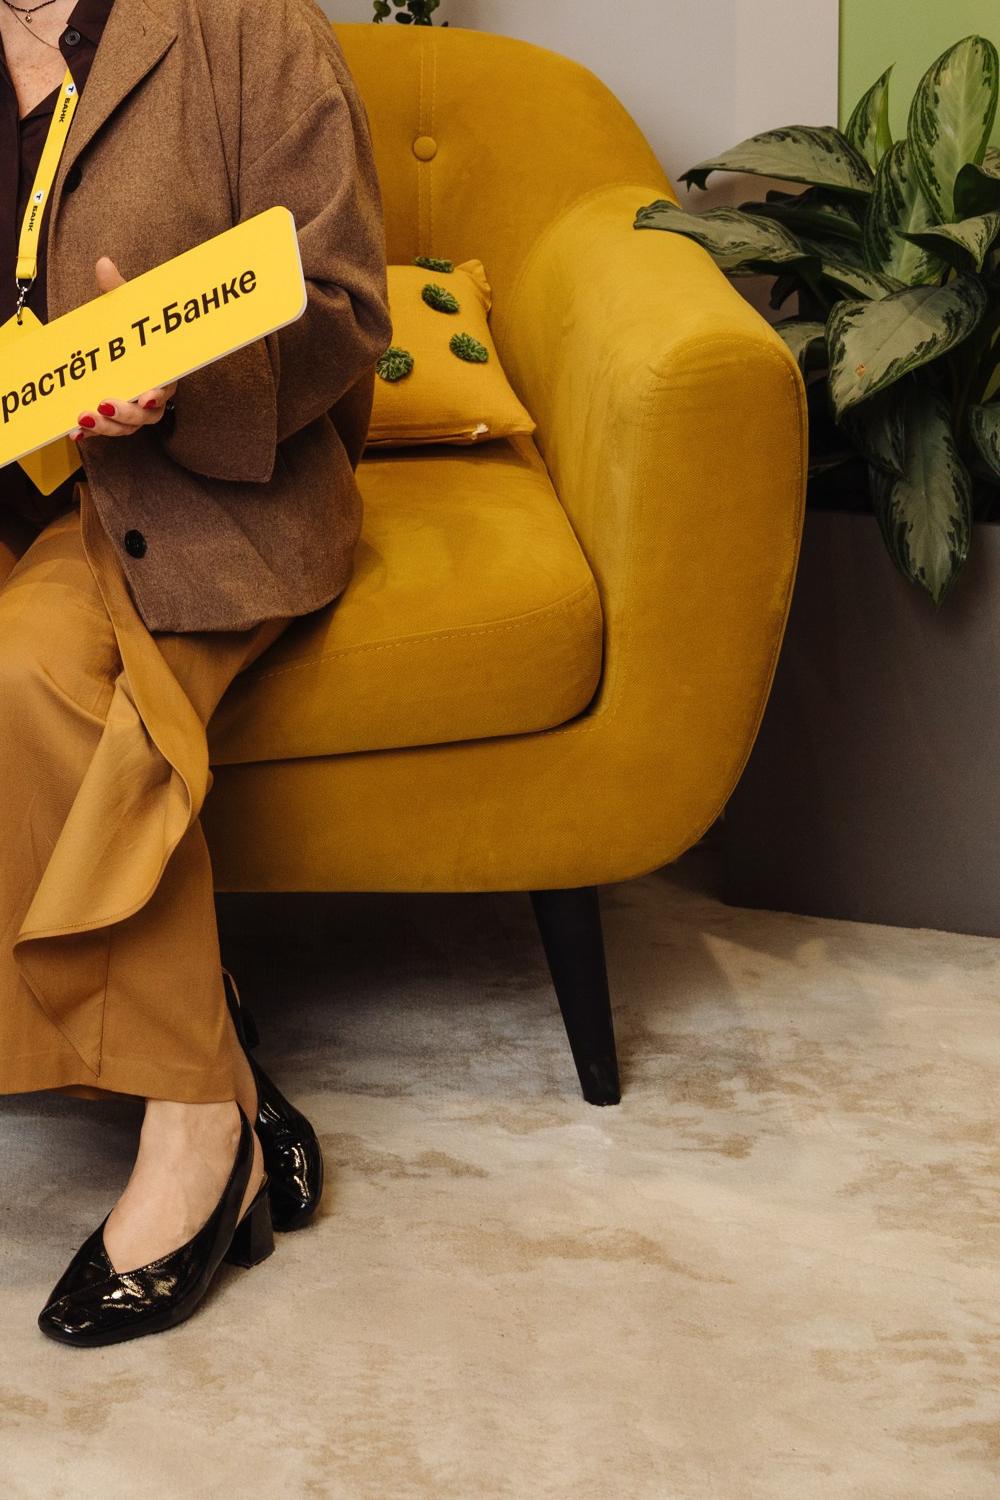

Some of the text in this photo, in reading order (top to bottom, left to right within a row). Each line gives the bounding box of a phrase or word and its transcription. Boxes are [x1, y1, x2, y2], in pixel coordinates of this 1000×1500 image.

[58, 97, 71, 123] БАНК
[27, 205, 38, 232] БАНК
[1, 347, 101, 424] растёт
[108, 336, 127, 362] в
[131, 269, 258, 347] Т-Банке
